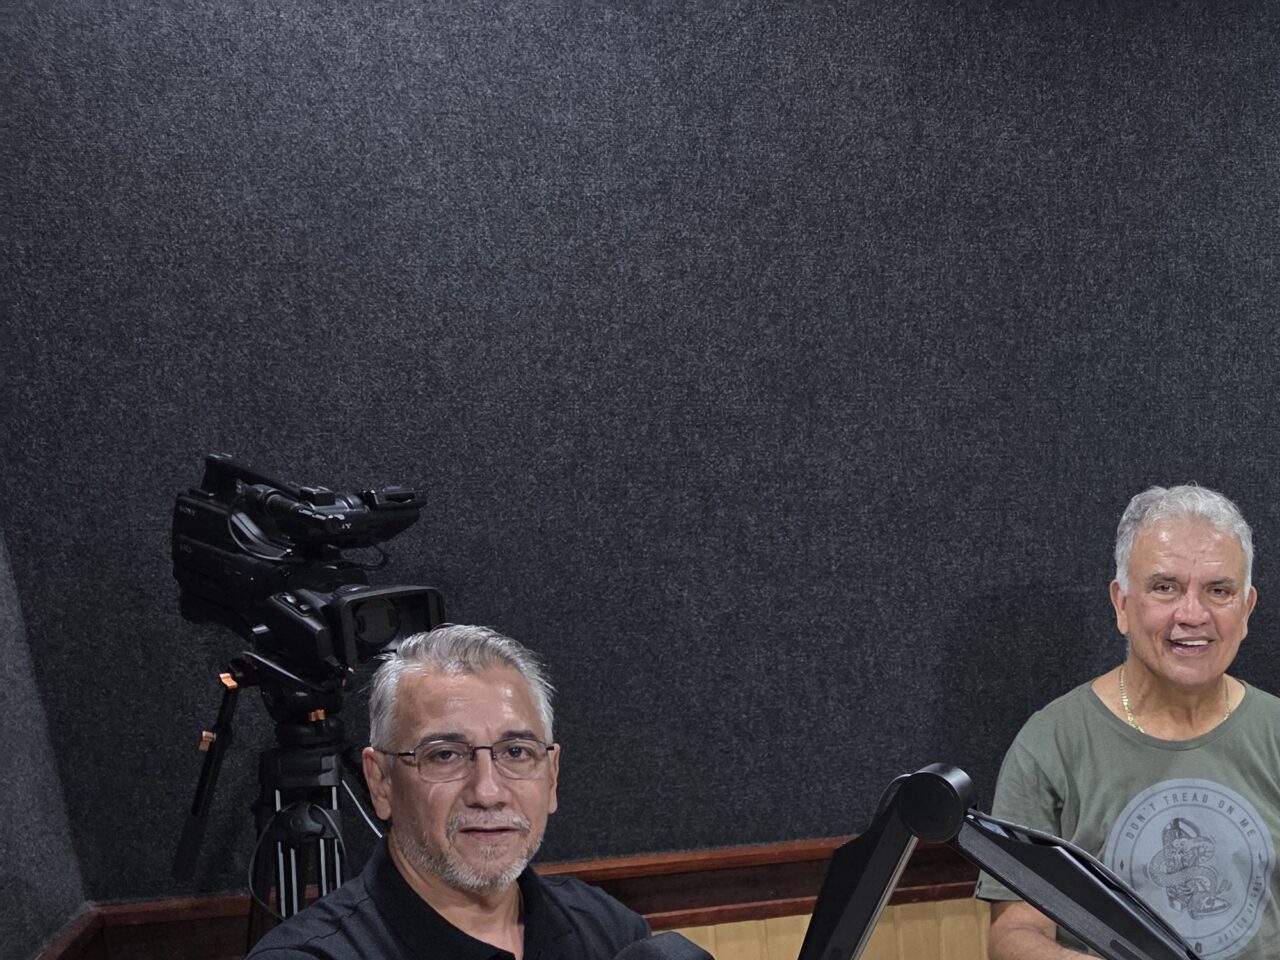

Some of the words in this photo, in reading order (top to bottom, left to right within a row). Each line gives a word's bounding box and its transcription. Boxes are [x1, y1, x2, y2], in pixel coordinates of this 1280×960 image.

[1126, 803, 1157, 840] DON'T
[1162, 792, 1208, 805] TREAD
[1218, 800, 1236, 815] ON
[1239, 818, 1257, 838] ME
